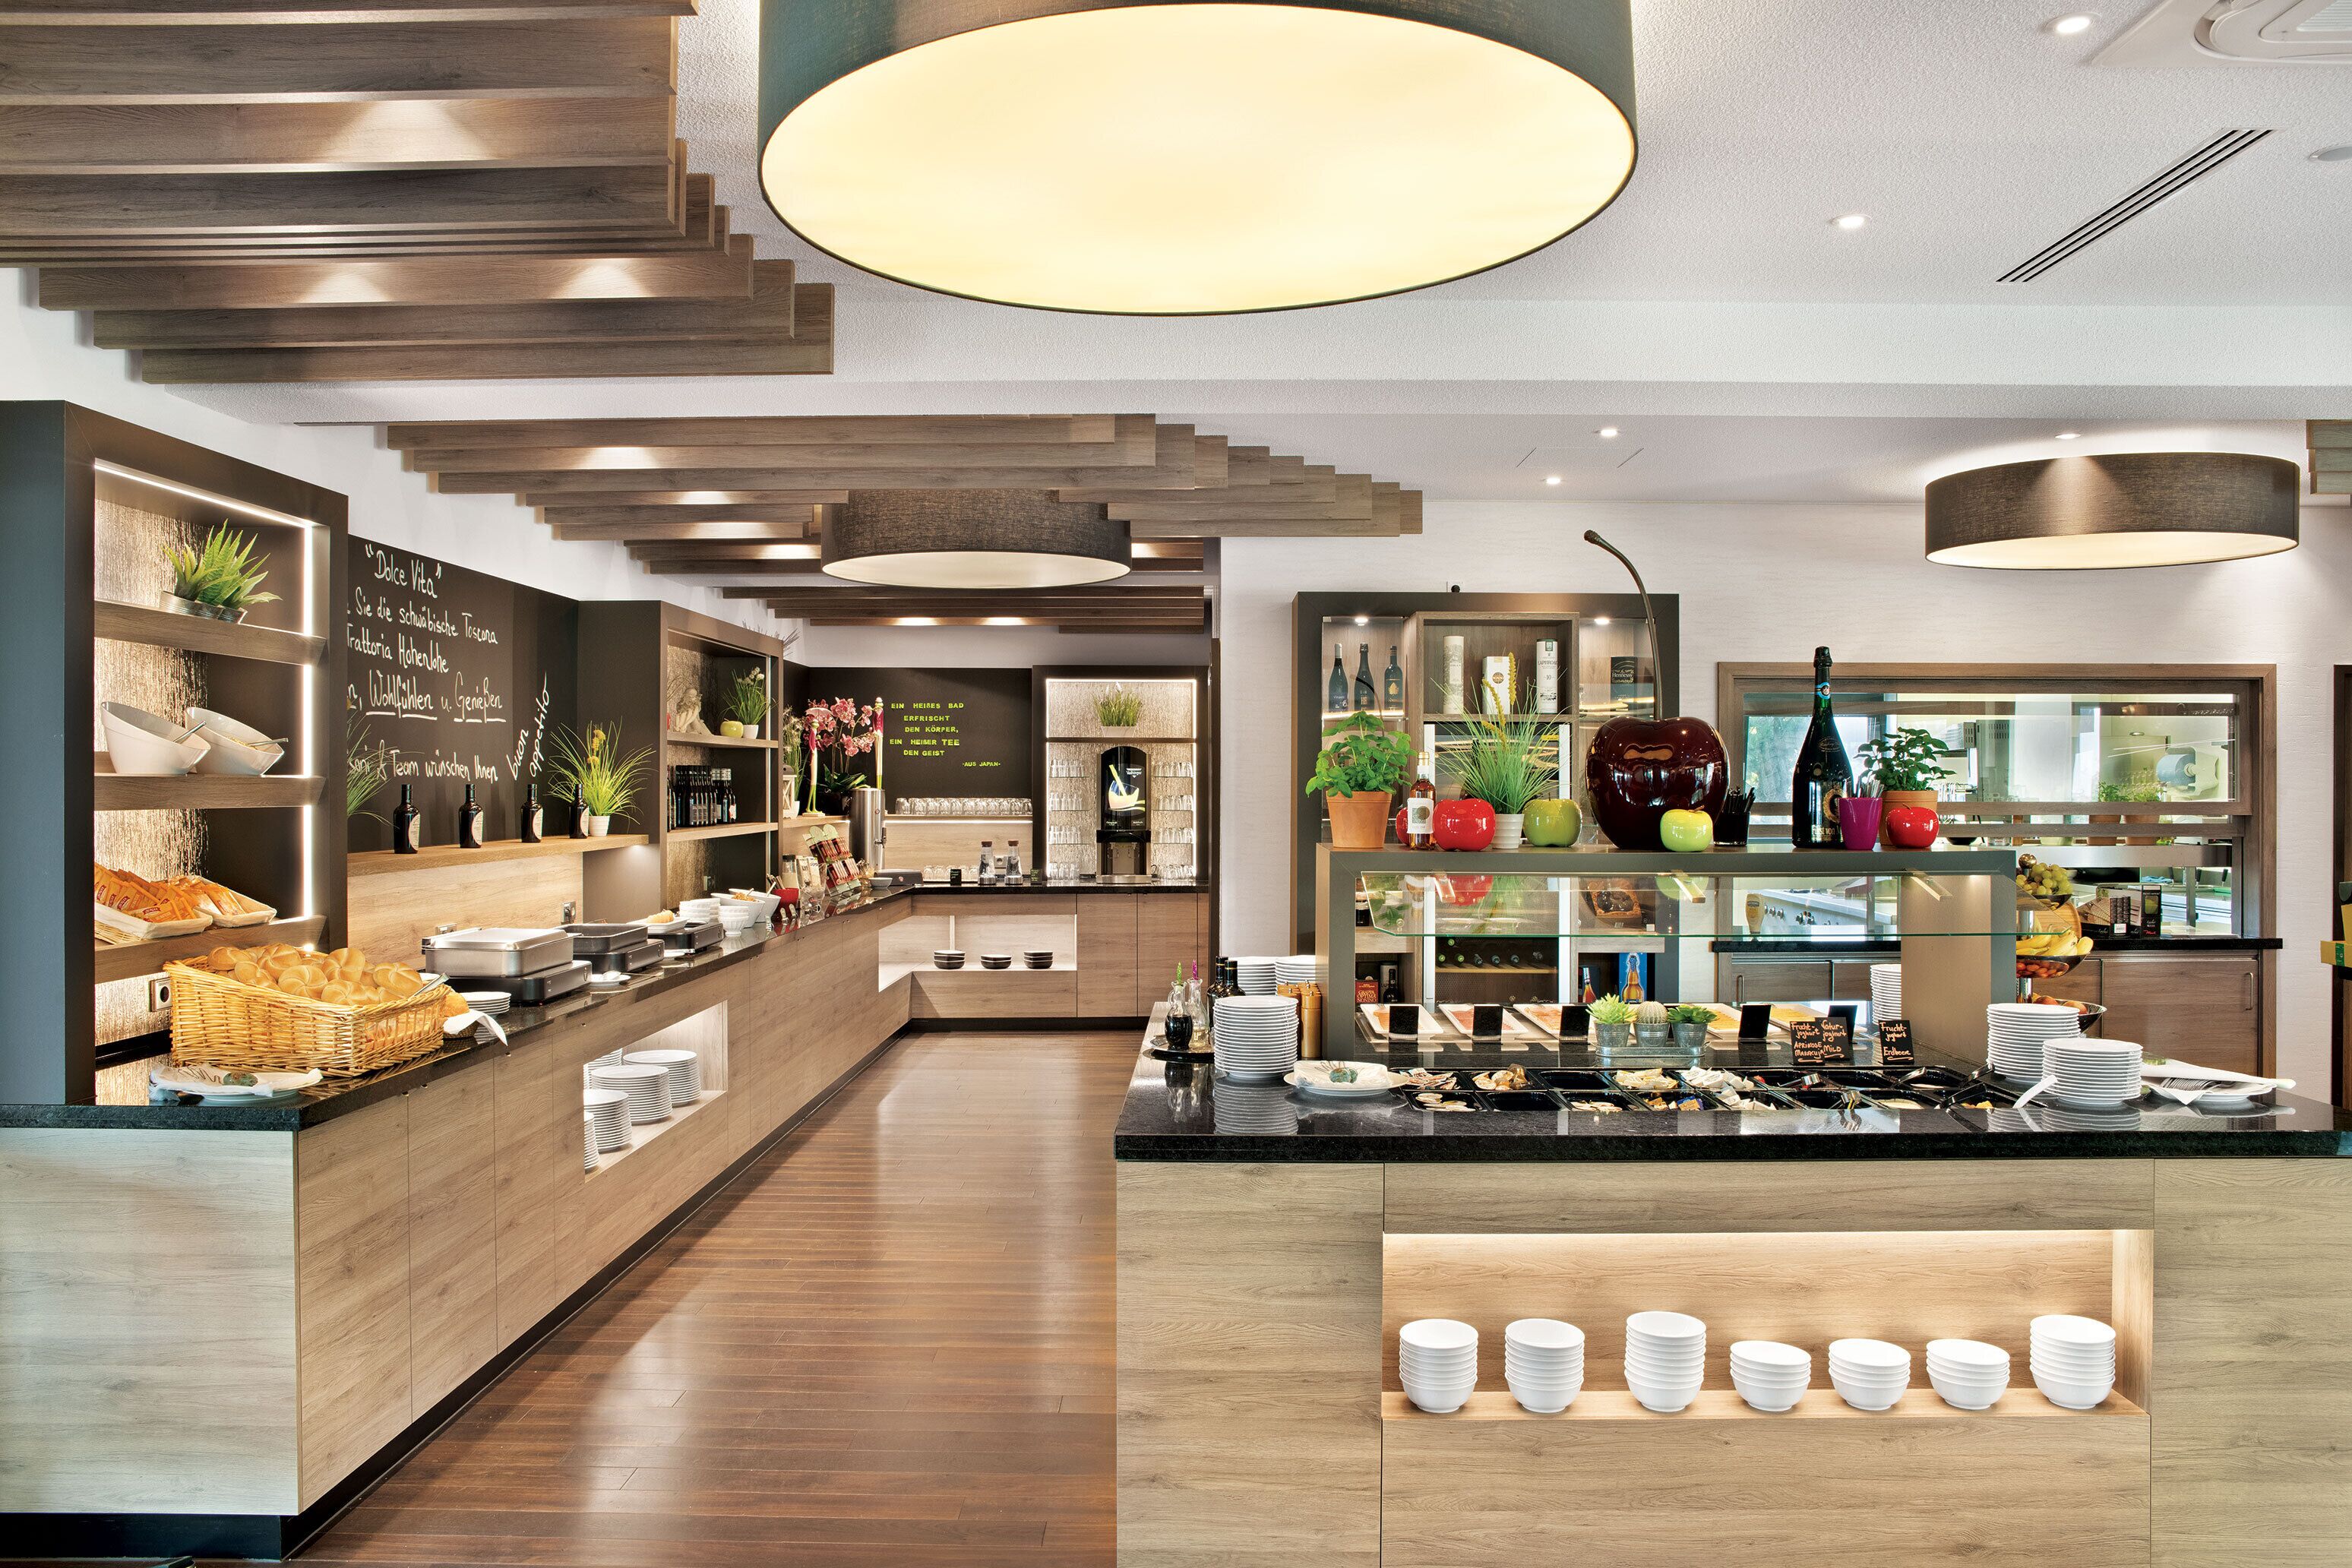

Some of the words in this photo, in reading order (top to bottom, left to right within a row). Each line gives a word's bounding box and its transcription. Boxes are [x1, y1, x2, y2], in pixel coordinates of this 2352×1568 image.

[356, 586, 372, 617] Sie
[377, 596, 393, 621] die
[399, 600, 459, 637] schwäbische
[347, 622, 393, 660] Trattoria
[399, 632, 449, 673] Hohenlohe
[369, 669, 434, 719] Wohlfühlen
[441, 696, 452, 713] u.
[455, 671, 503, 723] Genießen
[530, 671, 550, 778] appetito
[925, 725, 959, 734] KÖRPER,
[389, 748, 419, 777] Team
[425, 748, 471, 782] wünschen
[474, 754, 498, 784] Ihnen
[506, 729, 530, 781] buon
[1791, 1021, 1816, 1031] Frucht-
[1796, 1028, 1820, 1039] joghurt
[1822, 1029, 1848, 1042] joghurt
[1879, 1022, 1907, 1032] Frucht-
[1883, 1046, 1911, 1057] Erdbeere
